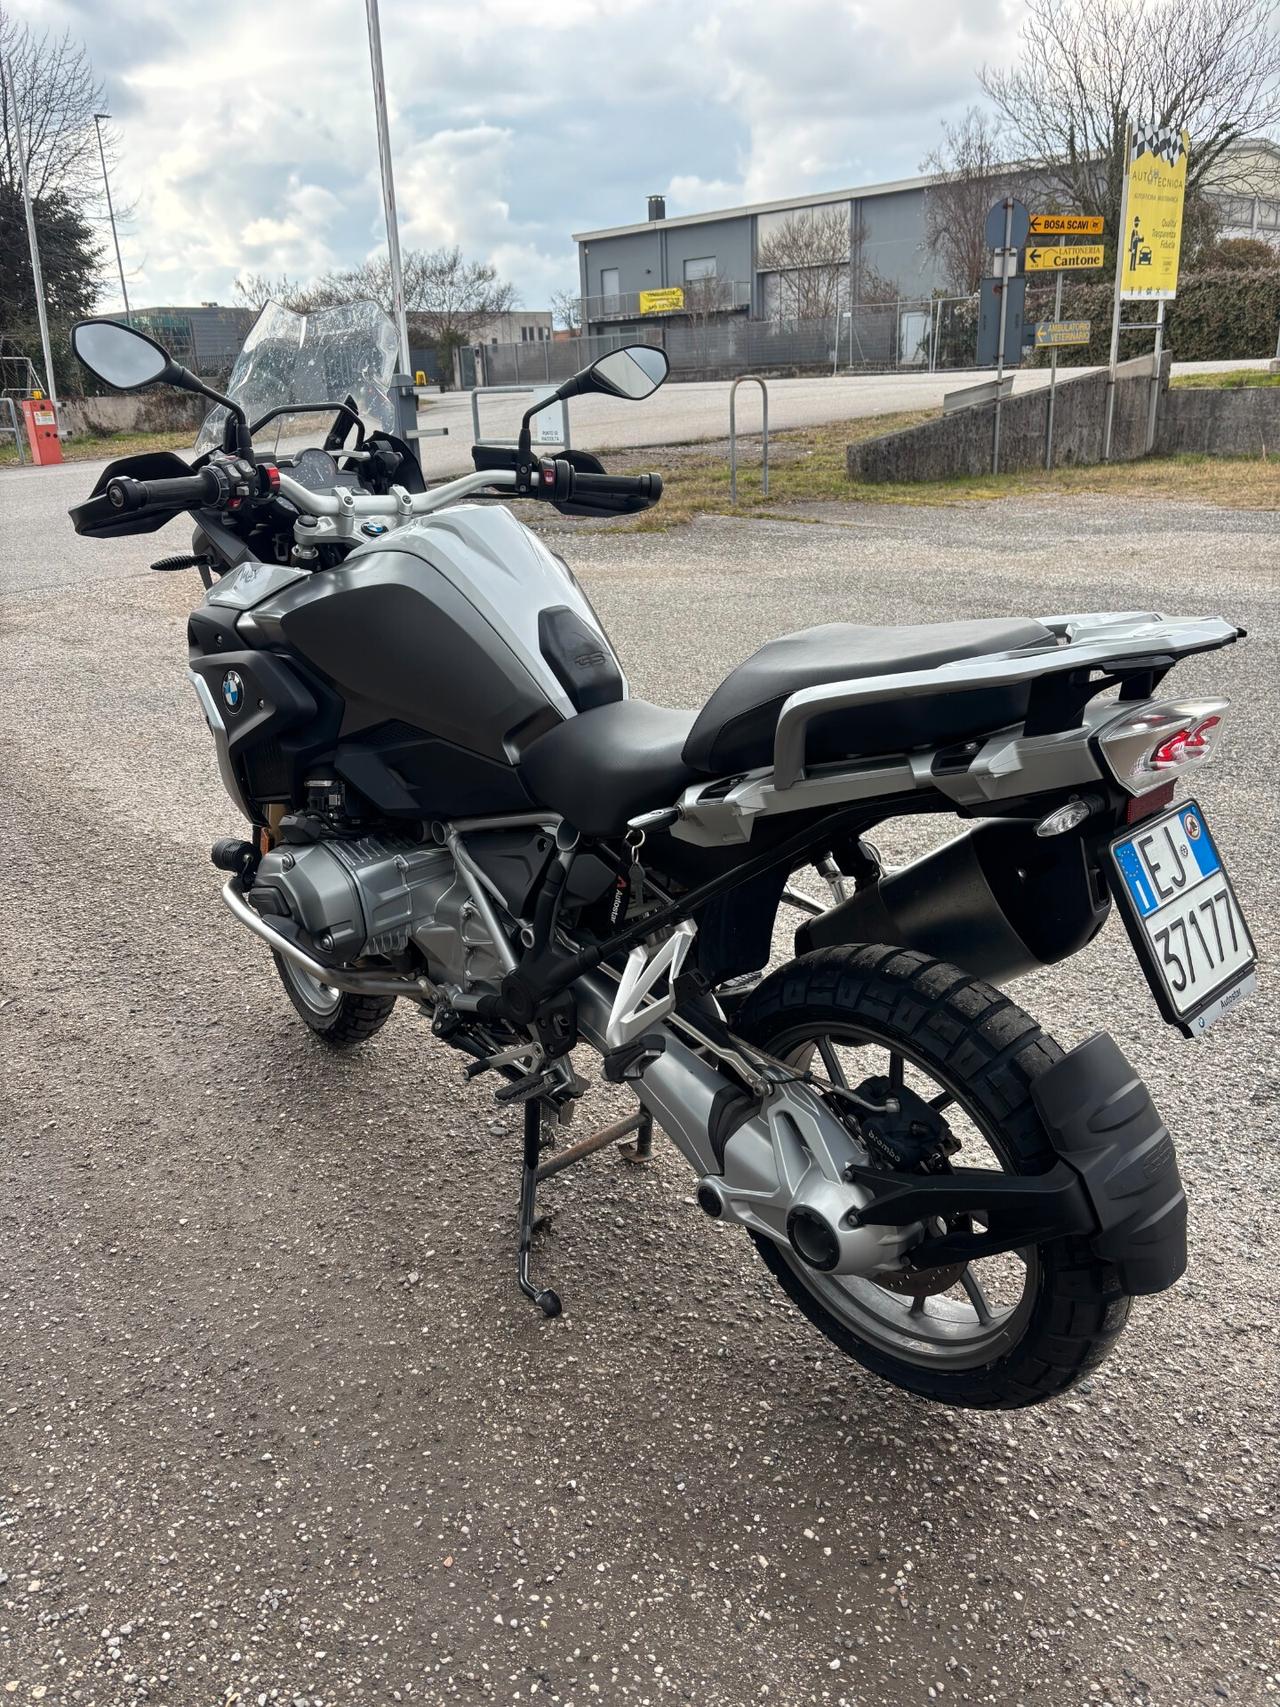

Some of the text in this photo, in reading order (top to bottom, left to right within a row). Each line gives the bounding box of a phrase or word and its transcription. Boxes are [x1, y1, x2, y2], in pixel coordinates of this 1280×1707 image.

[1132, 168, 1183, 189] AUTOTECNICA
[1044, 220, 1065, 229] BOSA
[1067, 220, 1088, 229] SCAVI
[1053, 254, 1100, 267] Cantone
[1059, 246, 1100, 255] LATTONERIA
[1138, 826, 1187, 900] EJ
[610, 889, 623, 924] Autostar
[1154, 888, 1238, 992] 37177
[1220, 987, 1242, 1009] Autostar
[868, 1130, 901, 1162] brembo
